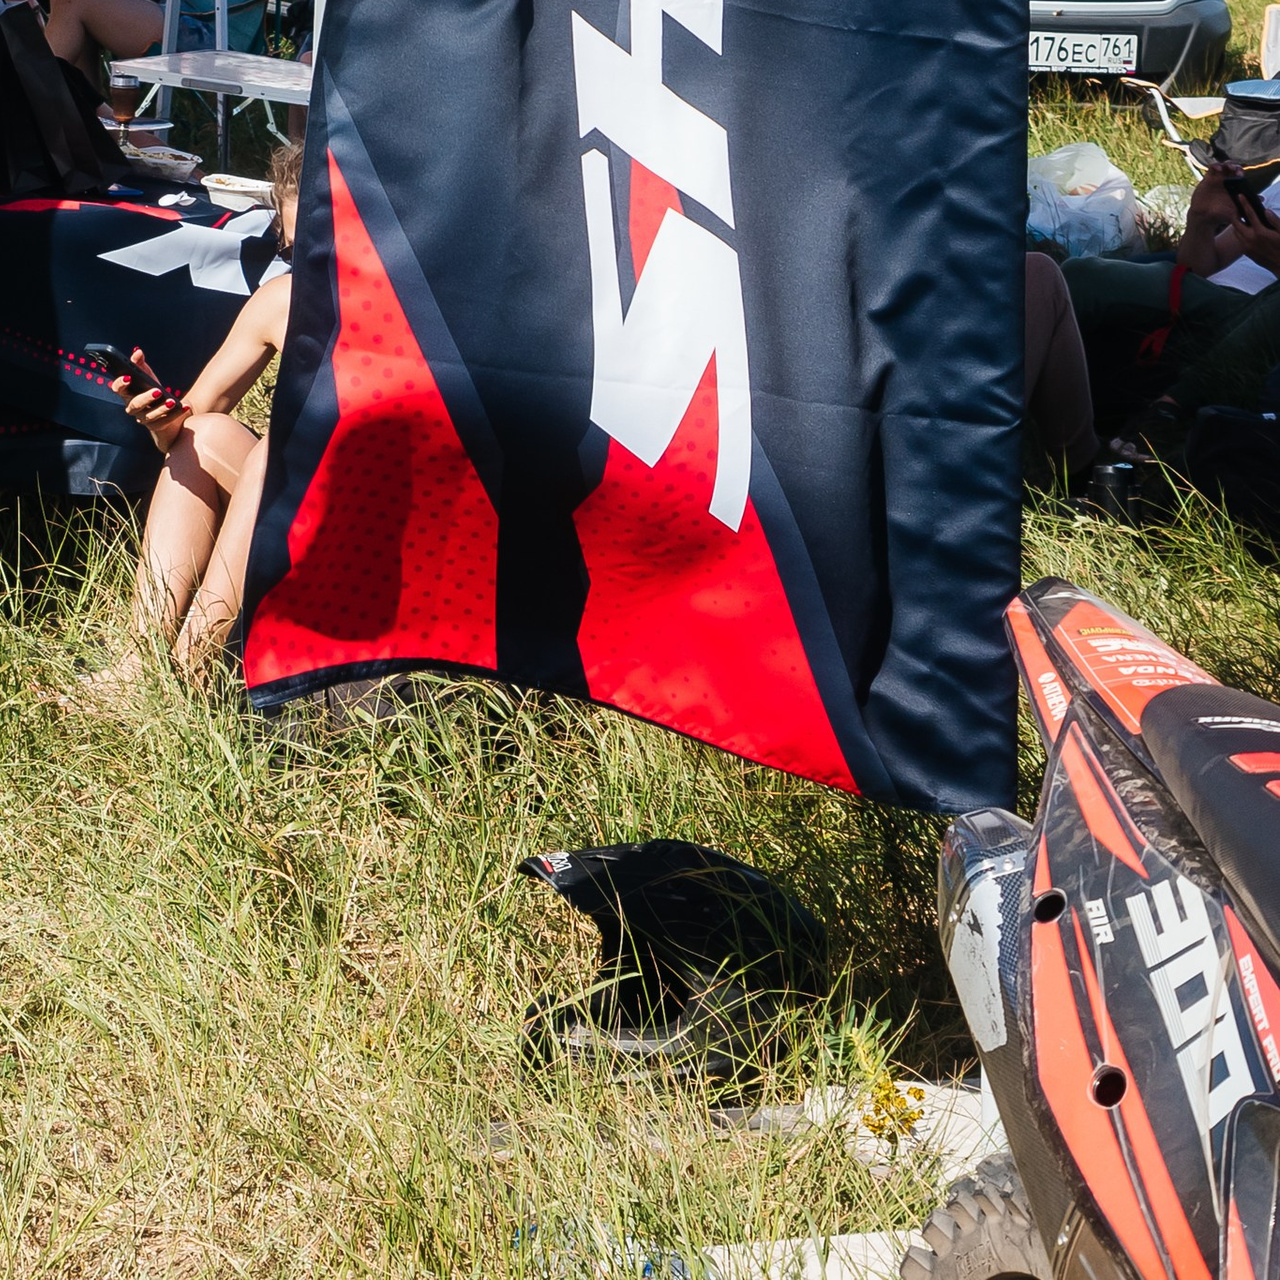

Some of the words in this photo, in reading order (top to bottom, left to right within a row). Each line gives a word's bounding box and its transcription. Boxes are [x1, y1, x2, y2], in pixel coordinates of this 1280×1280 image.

[1102, 37, 1133, 58] 761
[1107, 57, 1122, 65] RUS
[1042, 682, 1067, 722] ATHENA
[1085, 898, 1115, 945] AIR
[1239, 953, 1269, 1030] EXPERT
